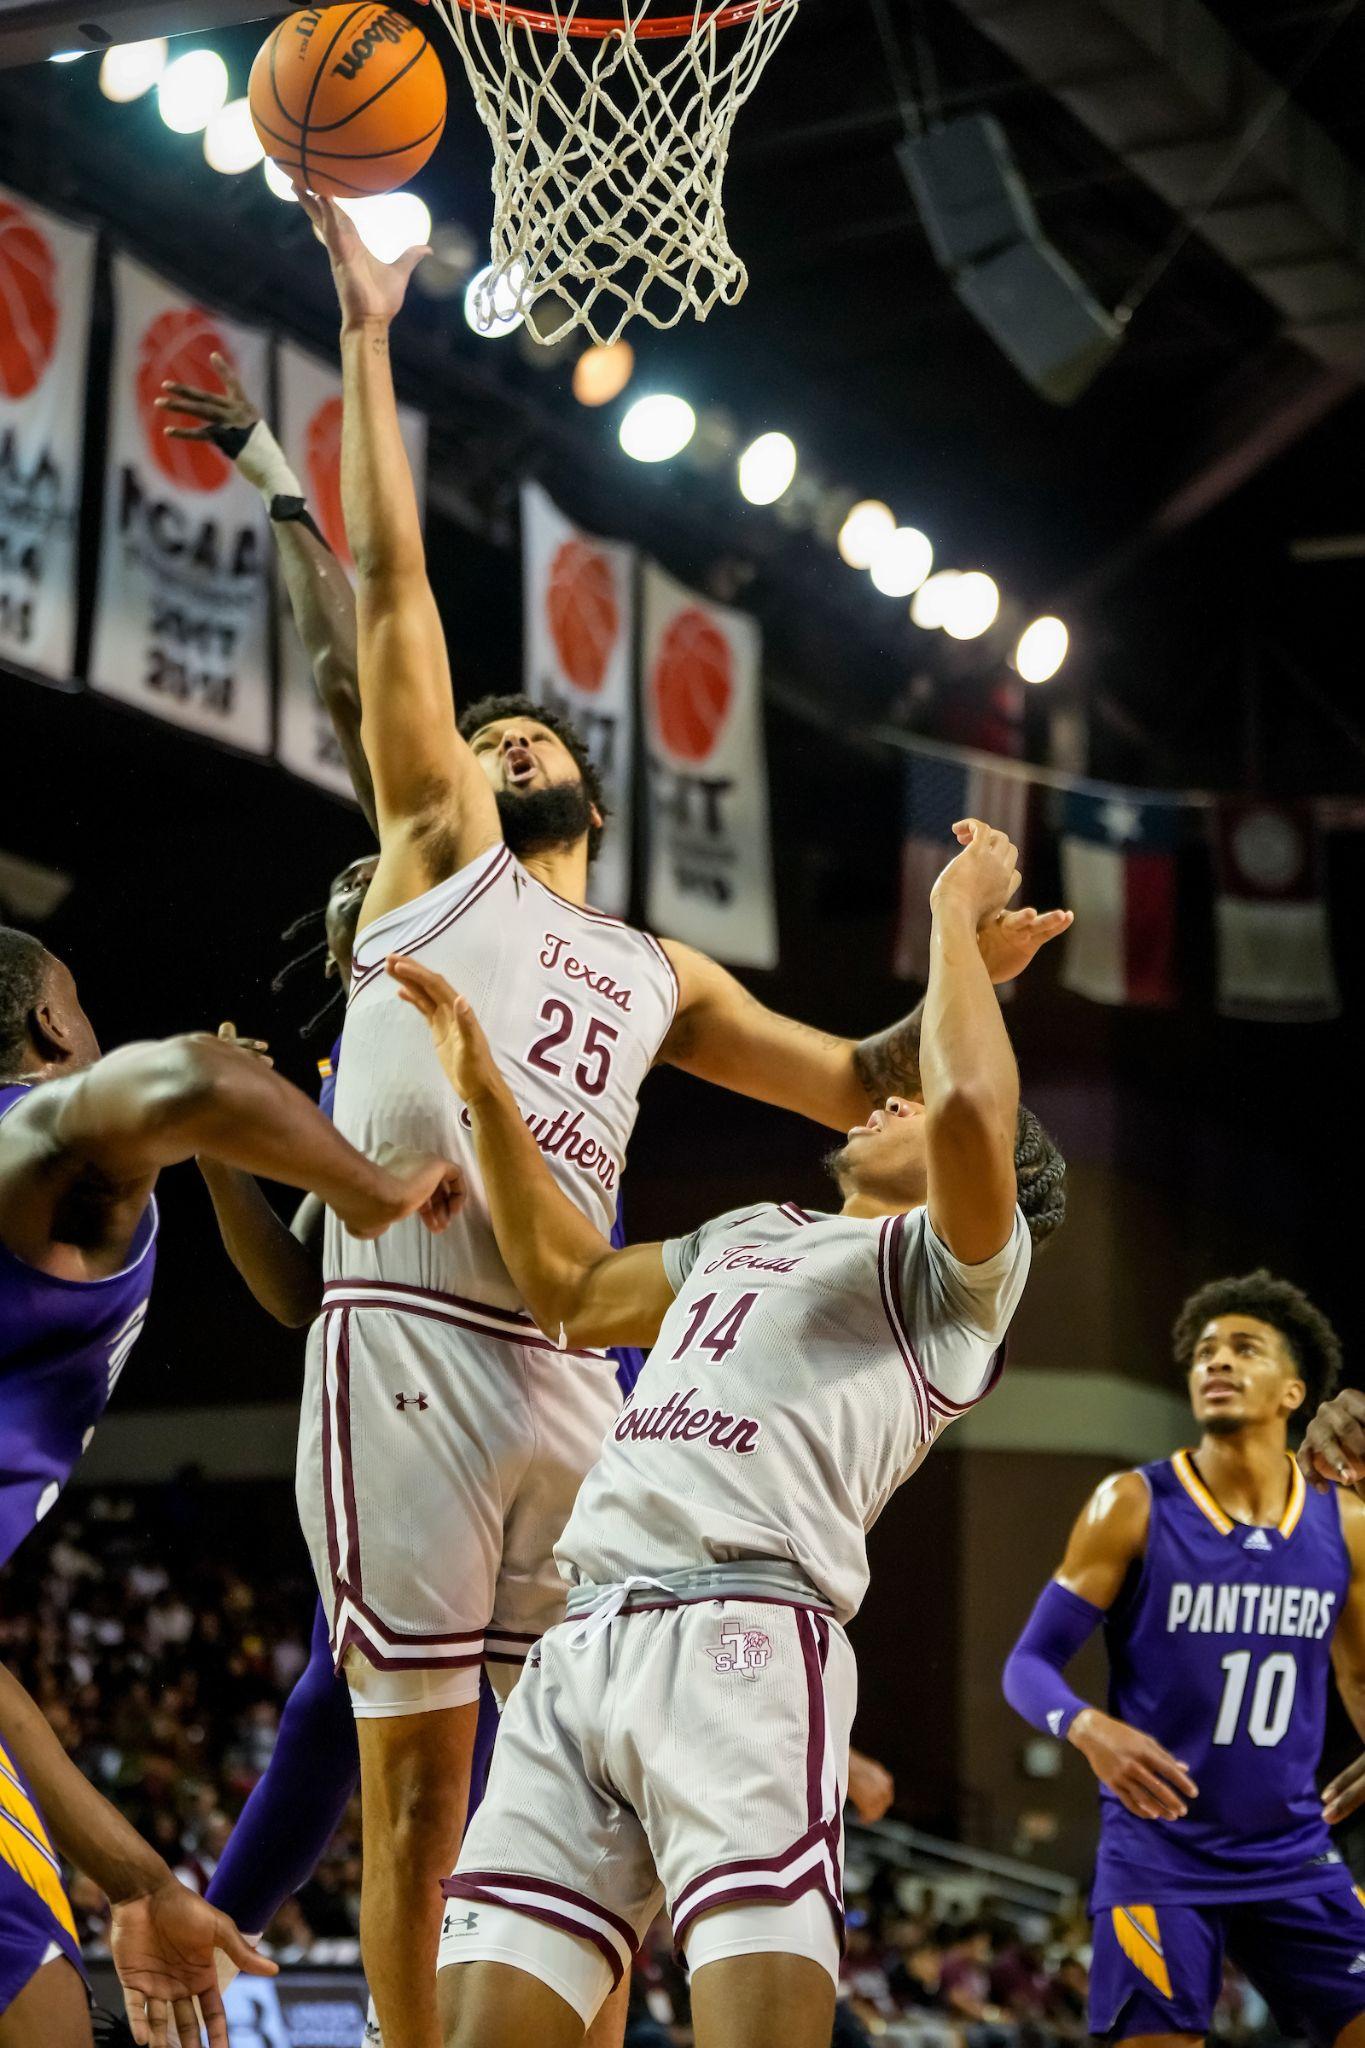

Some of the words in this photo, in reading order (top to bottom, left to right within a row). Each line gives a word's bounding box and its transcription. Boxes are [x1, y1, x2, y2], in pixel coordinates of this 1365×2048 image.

[539, 932, 632, 1012] Texas
[526, 998, 619, 1097] 25
[460, 1105, 617, 1191] uthern
[703, 1243, 807, 1276] Texas
[670, 1291, 760, 1362] 14
[614, 1386, 760, 1455] outhern
[1166, 1582, 1336, 1641] PANTHERS
[1212, 1650, 1298, 1748] 10
